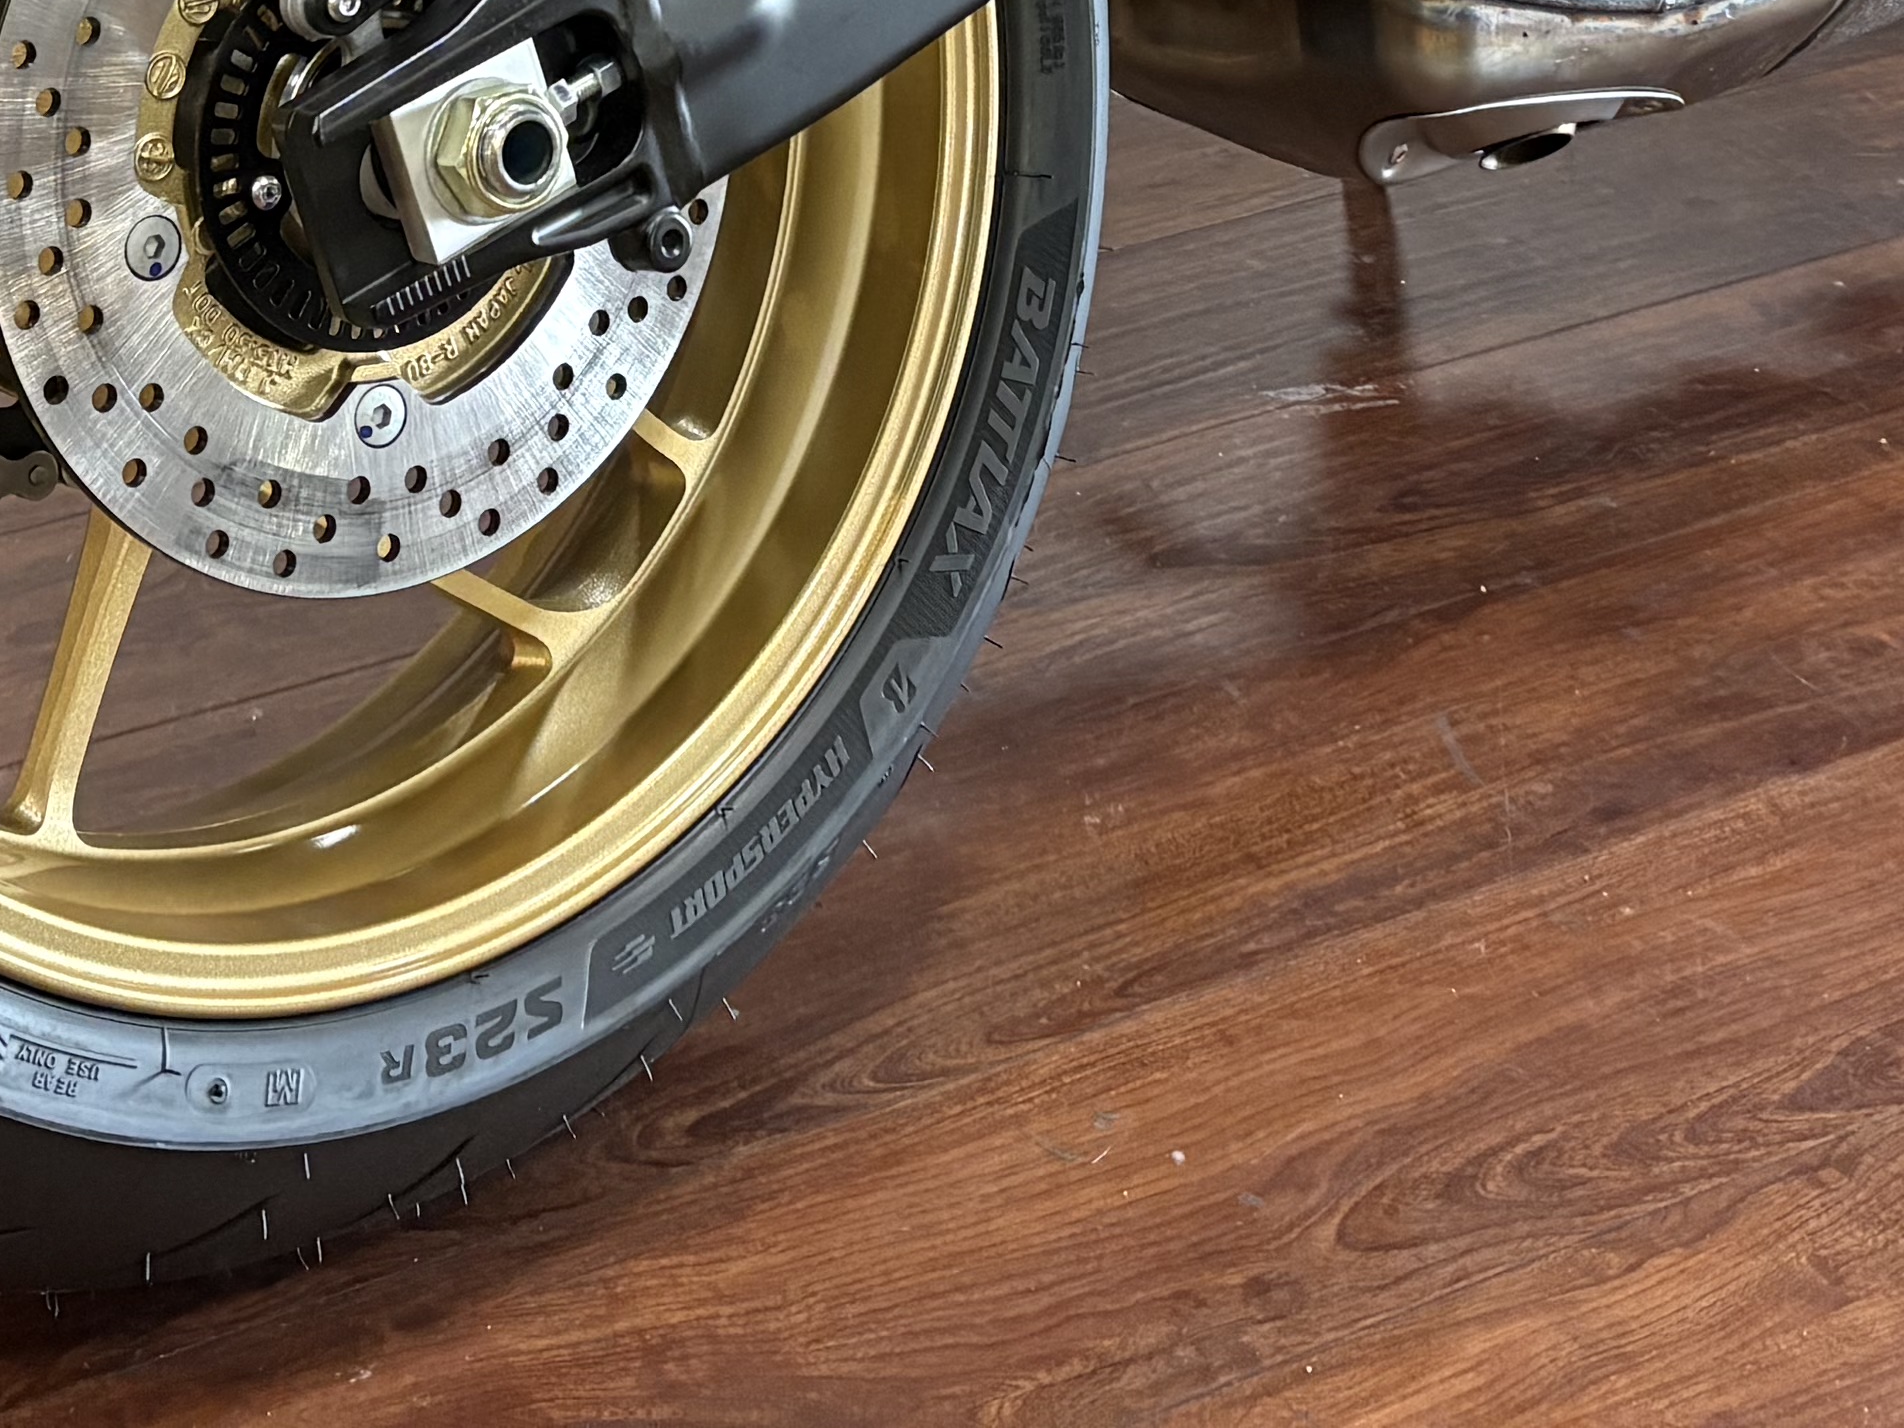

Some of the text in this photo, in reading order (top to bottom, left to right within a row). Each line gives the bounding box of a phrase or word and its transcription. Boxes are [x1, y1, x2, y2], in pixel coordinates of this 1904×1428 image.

[929, 265, 1058, 598] BATTLAX
[669, 734, 853, 940] HYPERSPORT
[14, 1042, 100, 1083] USE ONLY
[31, 1070, 78, 1098] REAR
